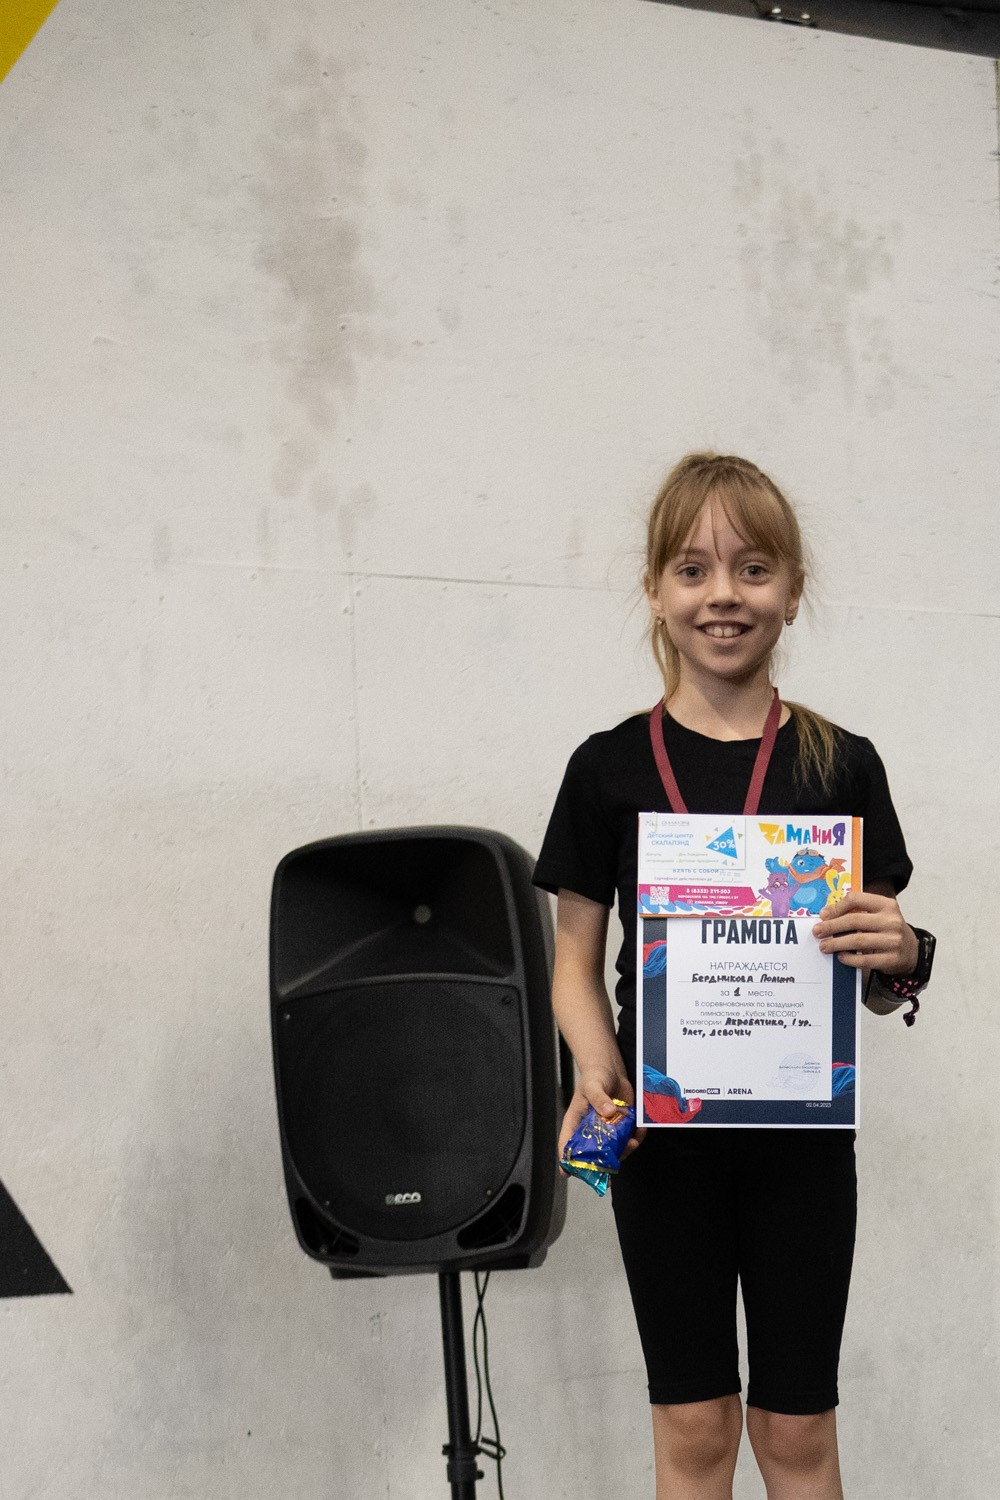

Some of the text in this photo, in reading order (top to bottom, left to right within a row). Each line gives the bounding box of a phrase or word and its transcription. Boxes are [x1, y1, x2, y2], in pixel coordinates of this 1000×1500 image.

[712, 839, 736, 850] 30%
[701, 919, 799, 945] ГРАМОТА
[710, 962, 788, 971] НАГРАЖДАЕТСЯ
[733, 986, 741, 997] 1
[766, 1000, 804, 1009] воздушной
